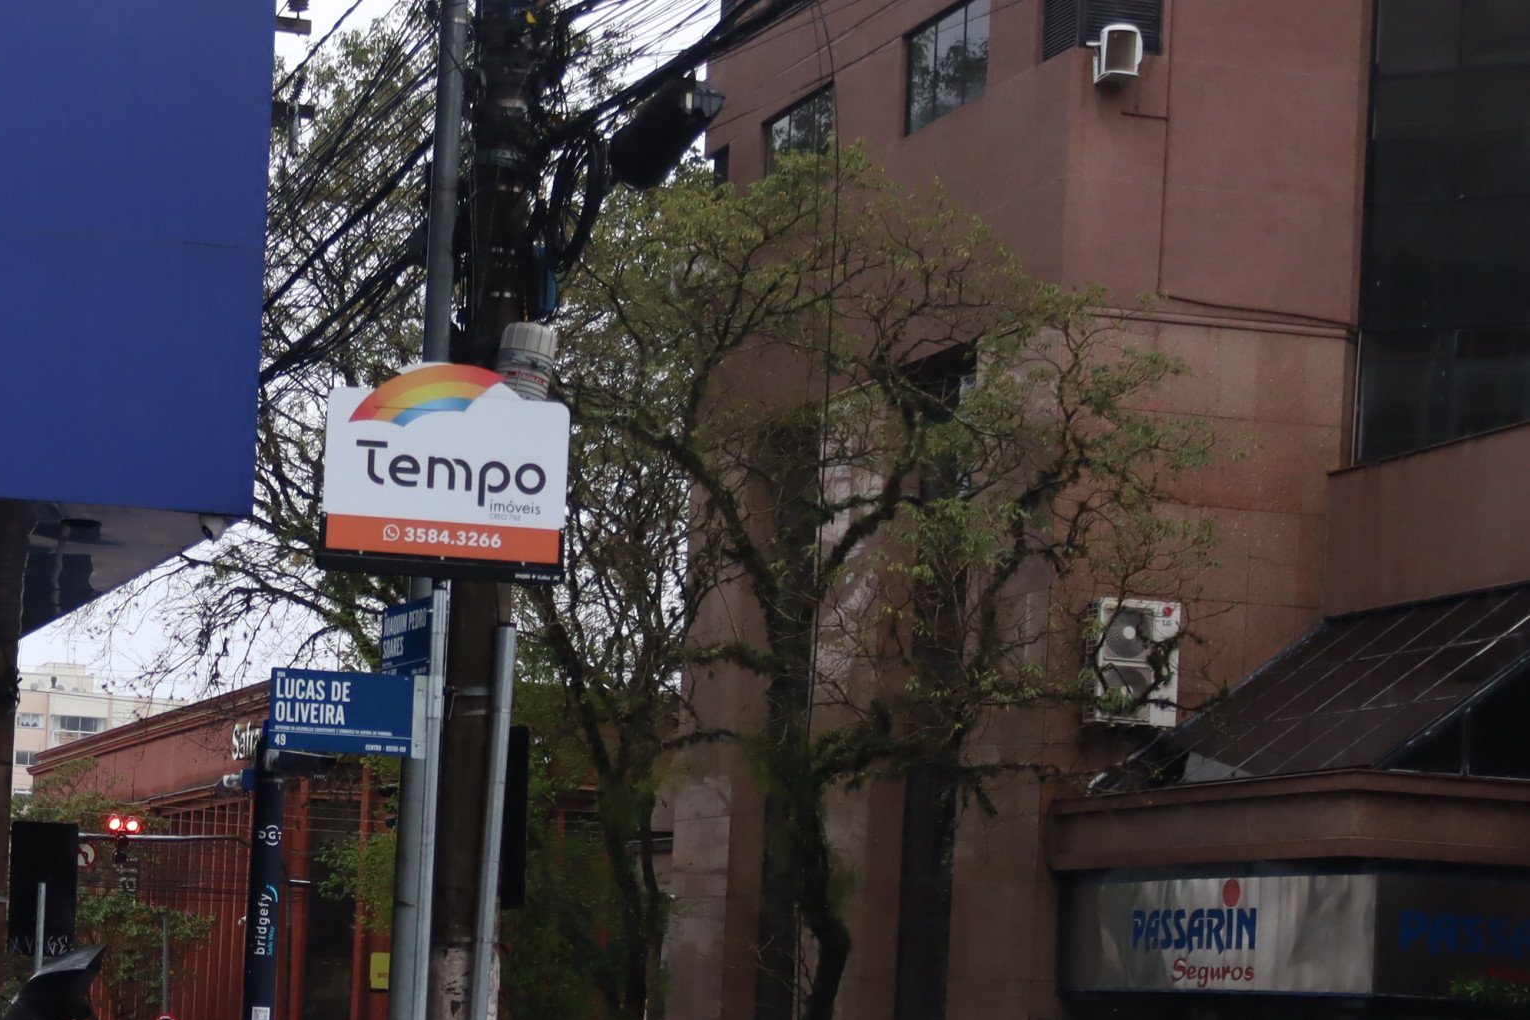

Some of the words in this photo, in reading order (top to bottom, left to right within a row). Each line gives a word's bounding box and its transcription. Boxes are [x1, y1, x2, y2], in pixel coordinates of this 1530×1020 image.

[356, 439, 546, 507] Tempo
[489, 499, 541, 516] imóveis
[489, 512, 508, 520] CRECI
[403, 526, 502, 549] 3584.3266
[382, 636, 404, 660] SOARES
[275, 677, 326, 701] LUCAS
[330, 680, 352, 703] DE
[274, 700, 346, 726] OLIVEIRA
[274, 733, 287, 746] 49
[254, 893, 273, 956] bridgefy
[1131, 907, 1257, 955] PASSARIN
[1170, 957, 1254, 987] Seguros
